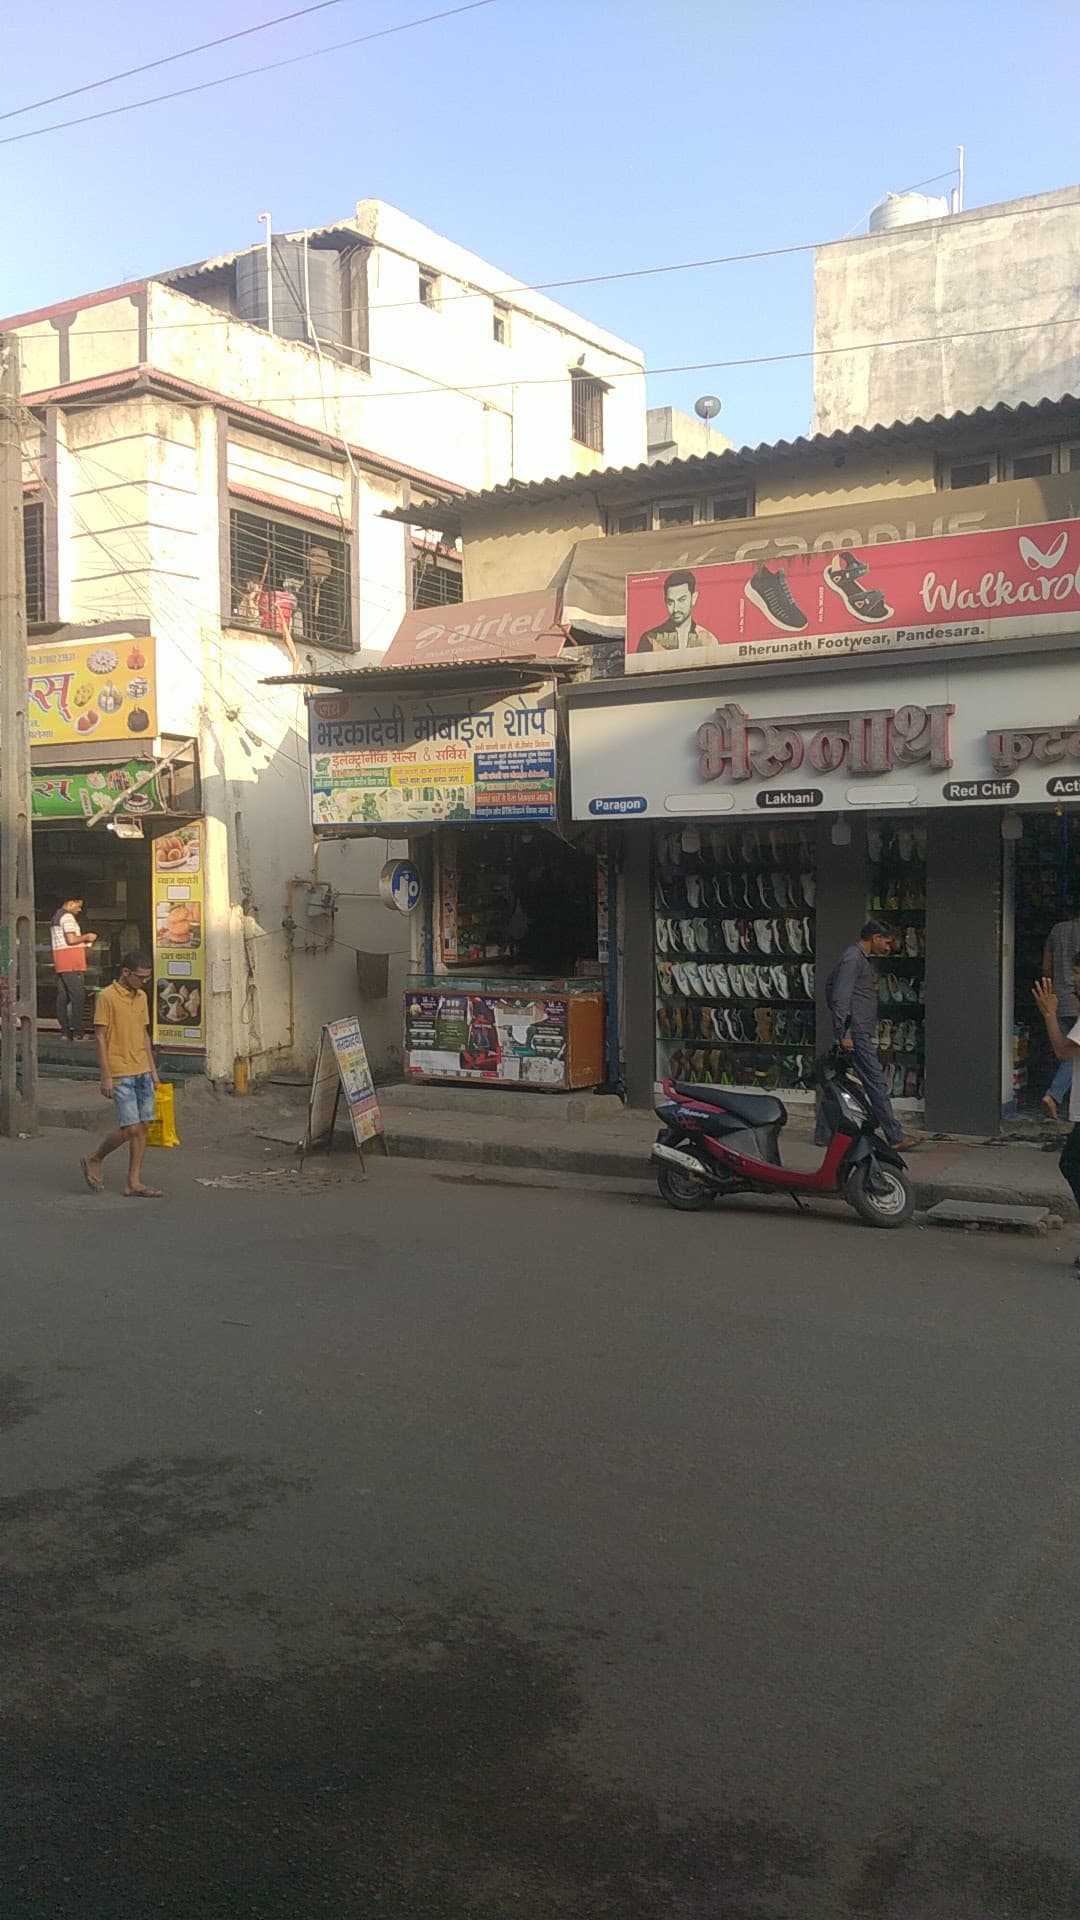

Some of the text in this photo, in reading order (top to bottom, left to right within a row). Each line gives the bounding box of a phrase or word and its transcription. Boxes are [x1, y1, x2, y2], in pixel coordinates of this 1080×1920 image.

[447, 608, 547, 645] airtel
[738, 626, 986, 657] Bherunath Footwear, Pandesara.
[423, 747, 433, 762] &
[949, 783, 1012, 797] Red Chif
[765, 792, 814, 804] Lakhani
[595, 800, 641, 813] Paragon
